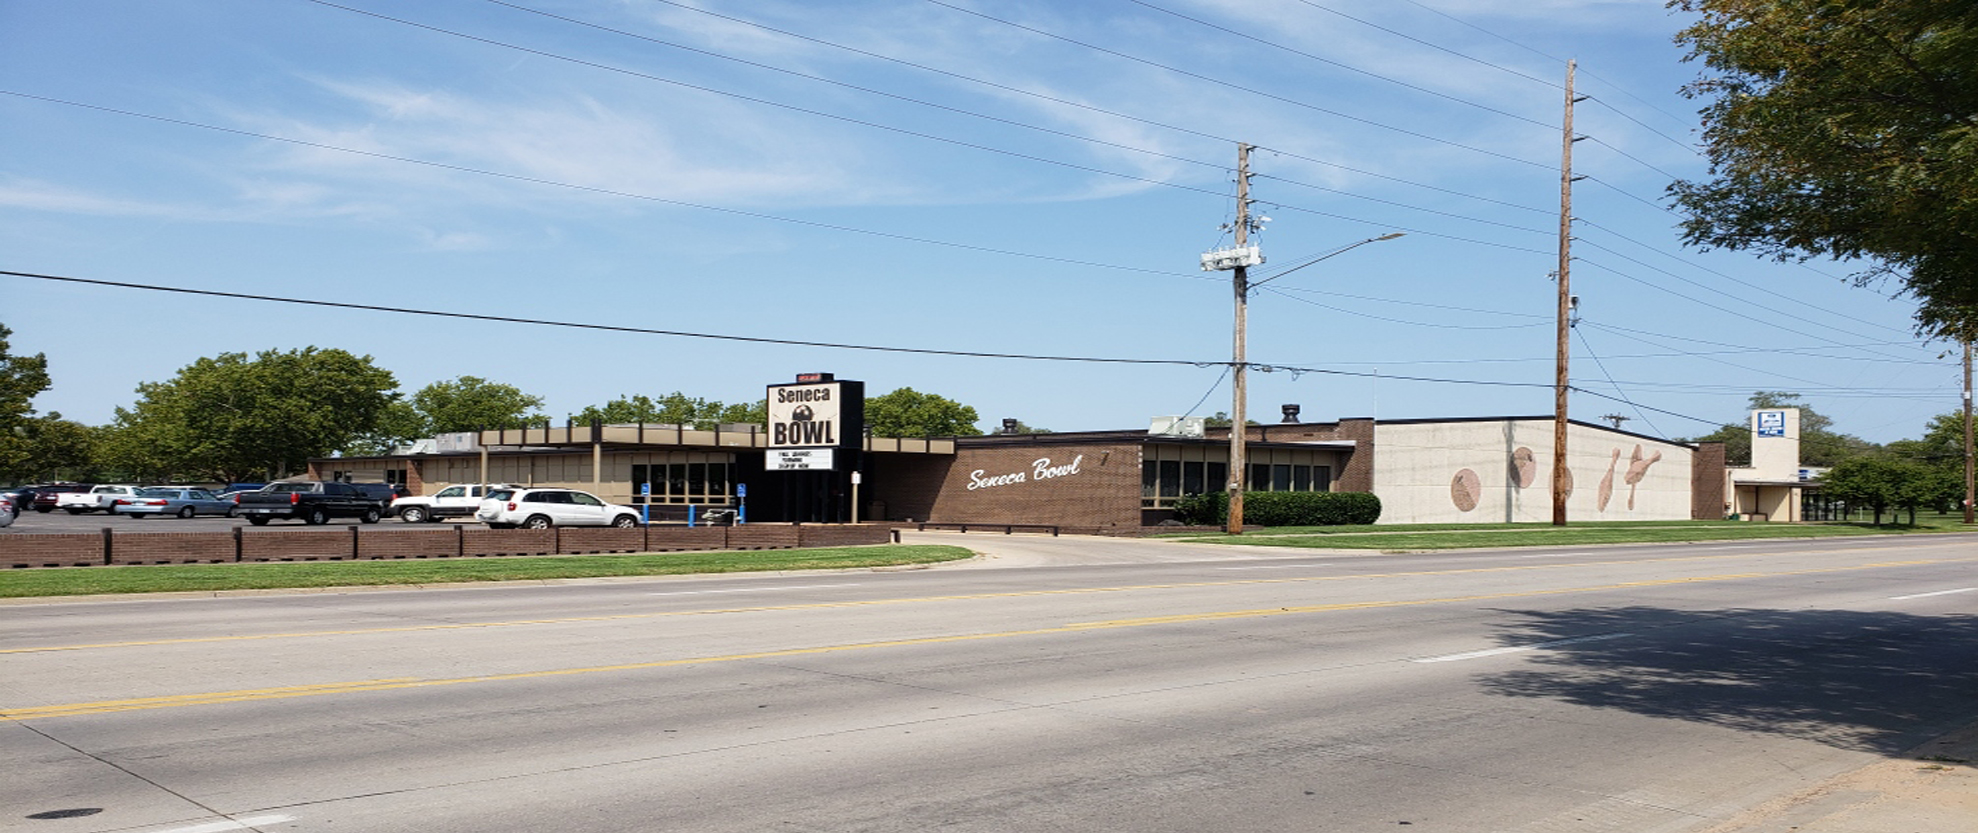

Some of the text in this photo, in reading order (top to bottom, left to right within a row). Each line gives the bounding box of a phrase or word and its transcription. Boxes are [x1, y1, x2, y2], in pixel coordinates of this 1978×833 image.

[778, 388, 830, 403] Seneca
[774, 421, 834, 445] BOWL
[967, 455, 1083, 491] Seneca Bowl
